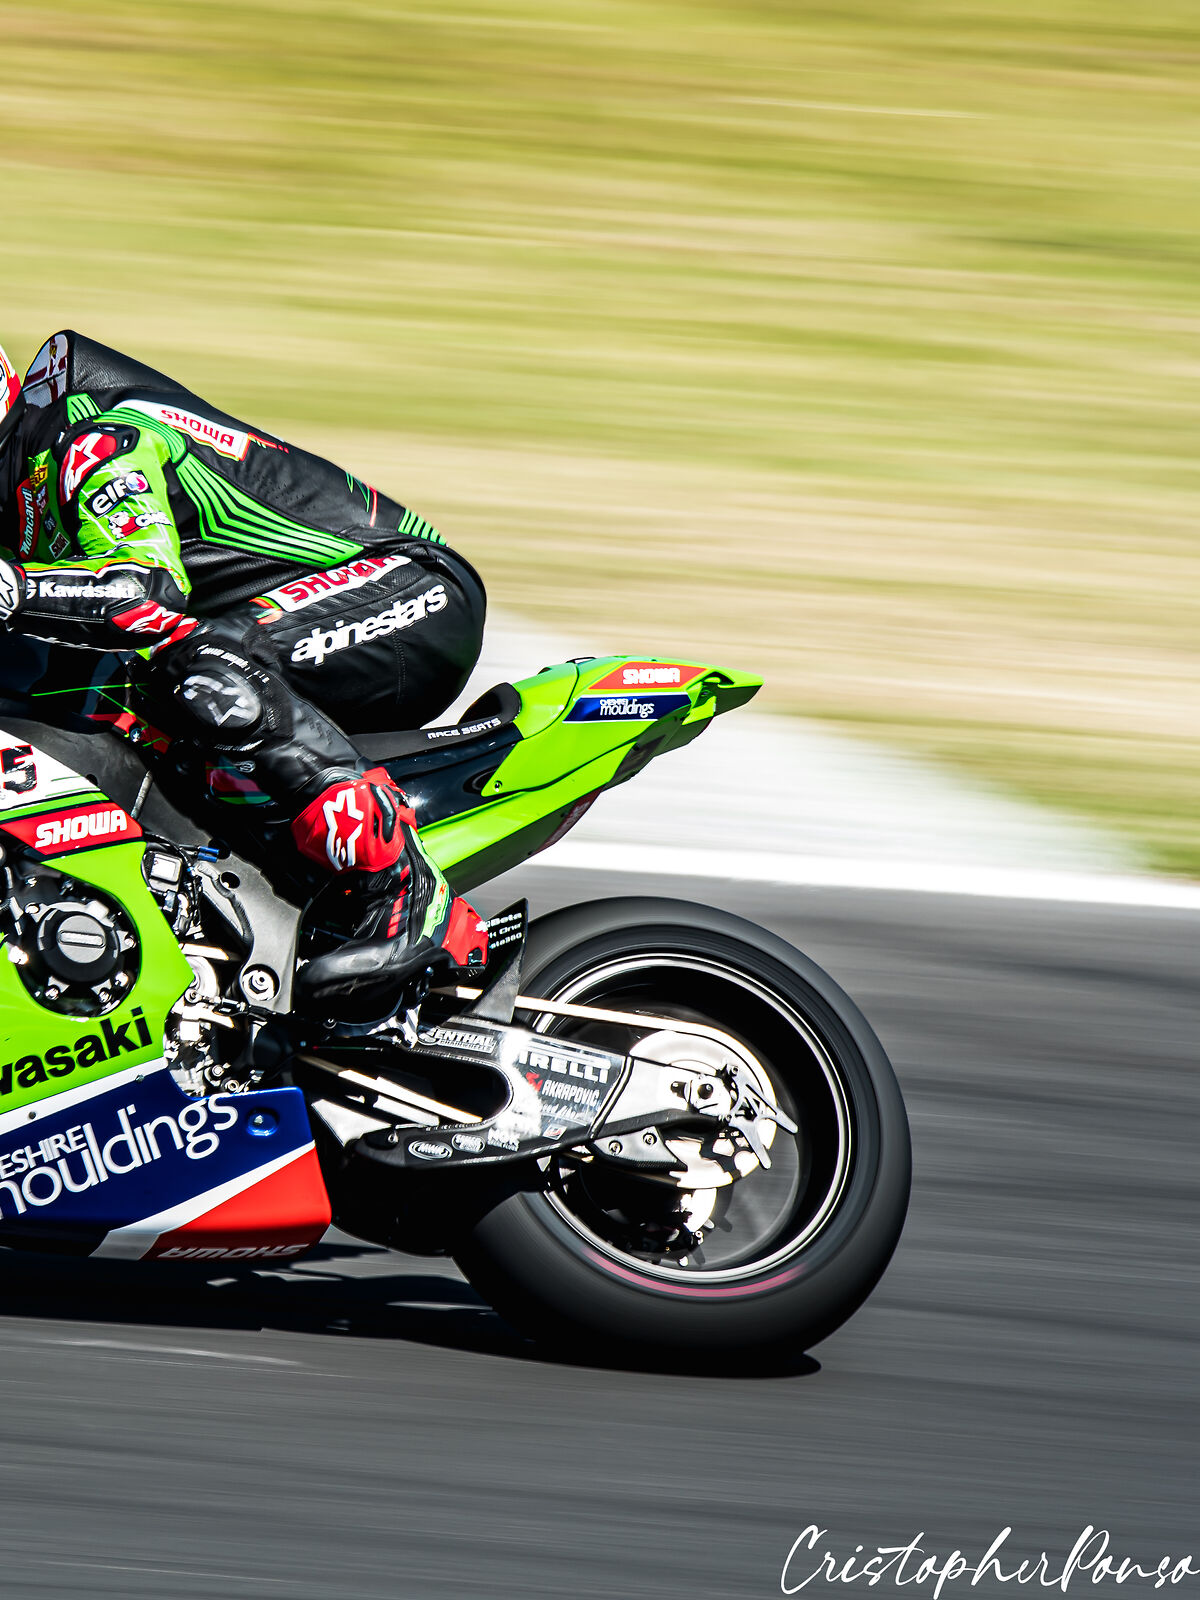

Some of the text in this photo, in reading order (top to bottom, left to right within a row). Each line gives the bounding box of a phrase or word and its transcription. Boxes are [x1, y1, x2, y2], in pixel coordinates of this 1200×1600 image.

[160, 409, 235, 447] SHOWA
[92, 481, 127, 513] elf
[39, 581, 136, 599] Kawasaki
[279, 556, 397, 603] SHOWA
[291, 585, 448, 666] alpinestars
[622, 667, 680, 685] SHOWA
[600, 699, 655, 718] mouldings
[427, 717, 502, 740] RACE SEATS
[34, 809, 128, 849] SHOWA
[508, 1045, 611, 1084] IRELLI
